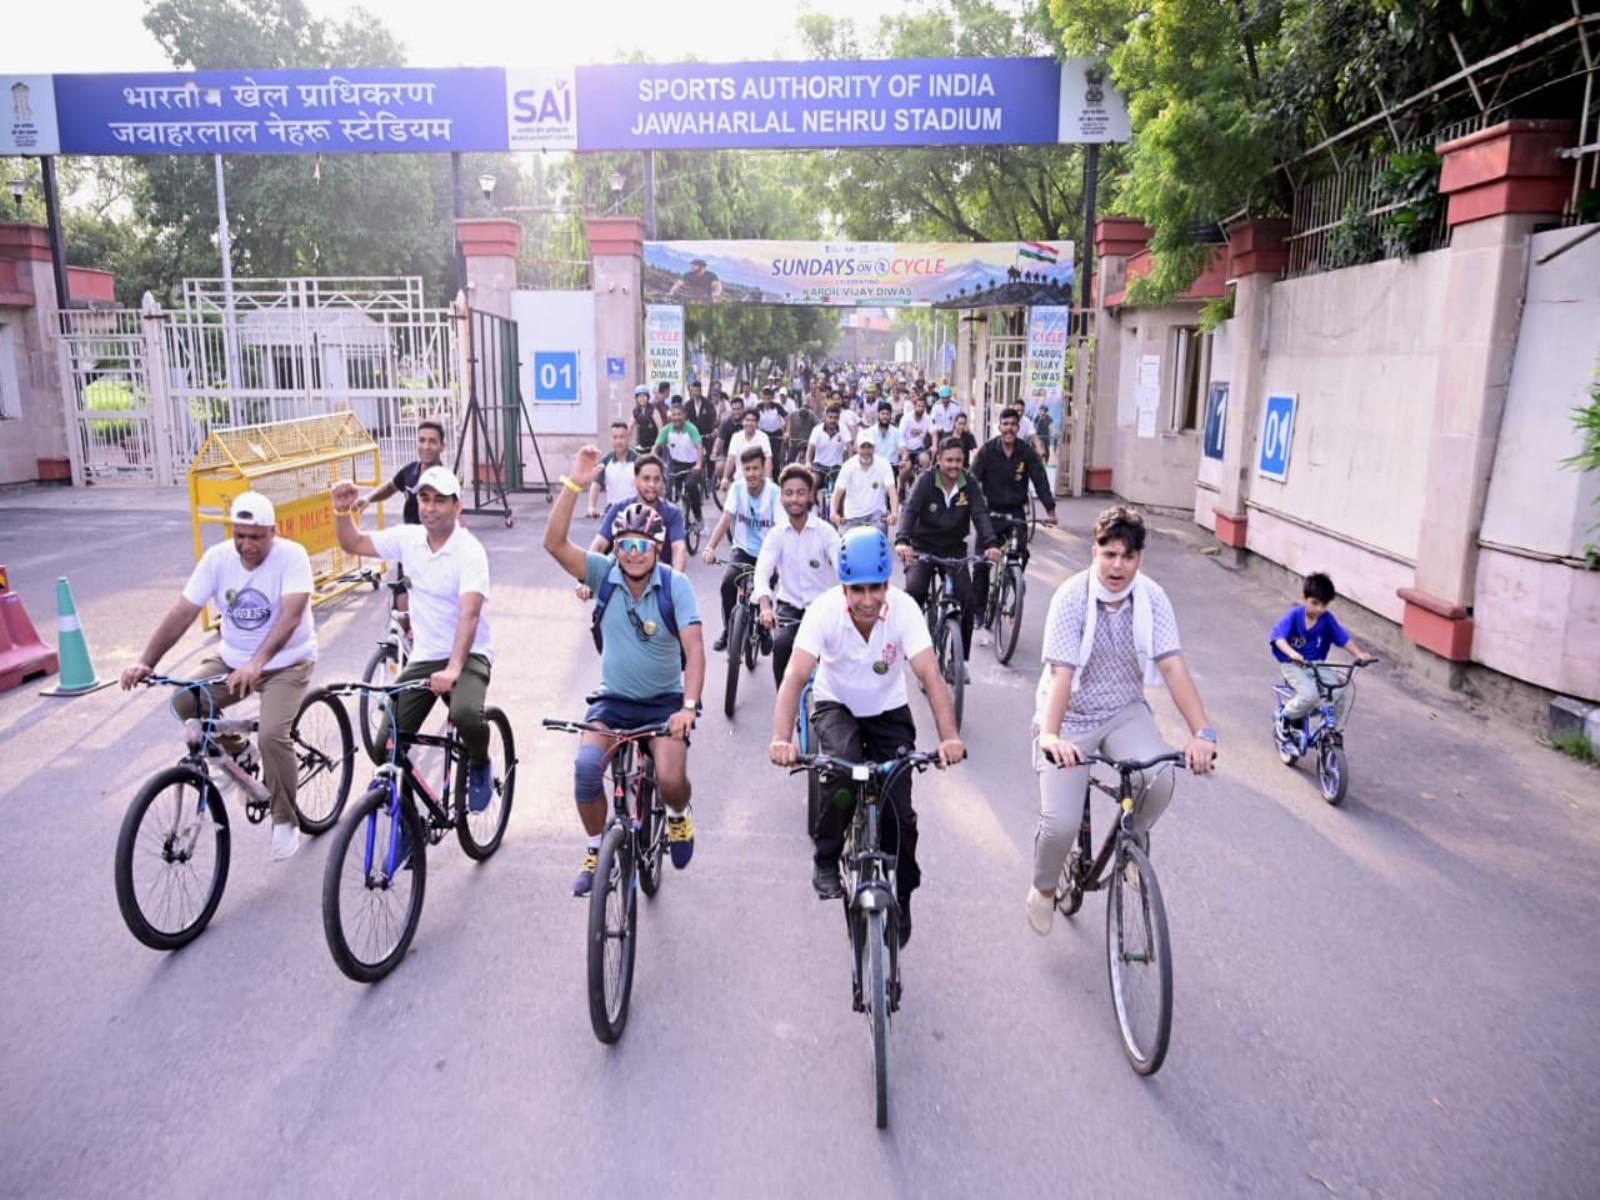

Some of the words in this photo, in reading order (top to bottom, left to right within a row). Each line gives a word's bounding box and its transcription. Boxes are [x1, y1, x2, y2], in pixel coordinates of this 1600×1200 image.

[230, 76, 289, 108] खेल
[297, 75, 436, 108] प्राधिकरण
[637, 77, 736, 102] SPORTS
[742, 75, 881, 100] AUTHORITY
[888, 74, 922, 99] OF
[929, 72, 995, 98] INDIA
[513, 89, 571, 124] SAI
[108, 120, 258, 147] जवाहरलाल
[264, 111, 332, 146] नेहरू
[338, 110, 453, 143] स्टेडियम
[631, 109, 796, 136] JAWAHARLAL
[802, 108, 887, 133] NEHRU
[894, 106, 1002, 132] STADIUM
[771, 258, 855, 276] SUNDAYS
[857, 264, 872, 273] ON
[891, 258, 945, 275] CYCLE
[803, 287, 840, 297] KARGIL
[843, 287, 873, 296] VIJAY
[876, 287, 912, 296] DIWAS
[1032, 332, 1064, 343] CYCLE
[650, 348, 679, 357] KARGIL
[1032, 349, 1062, 358] KARGIL
[653, 360, 677, 369] VIJAY
[541, 363, 571, 389] 01
[650, 371, 679, 380] DIWAS
[1032, 373, 1060, 382] DIWAS
[1265, 410, 1290, 461] 01
